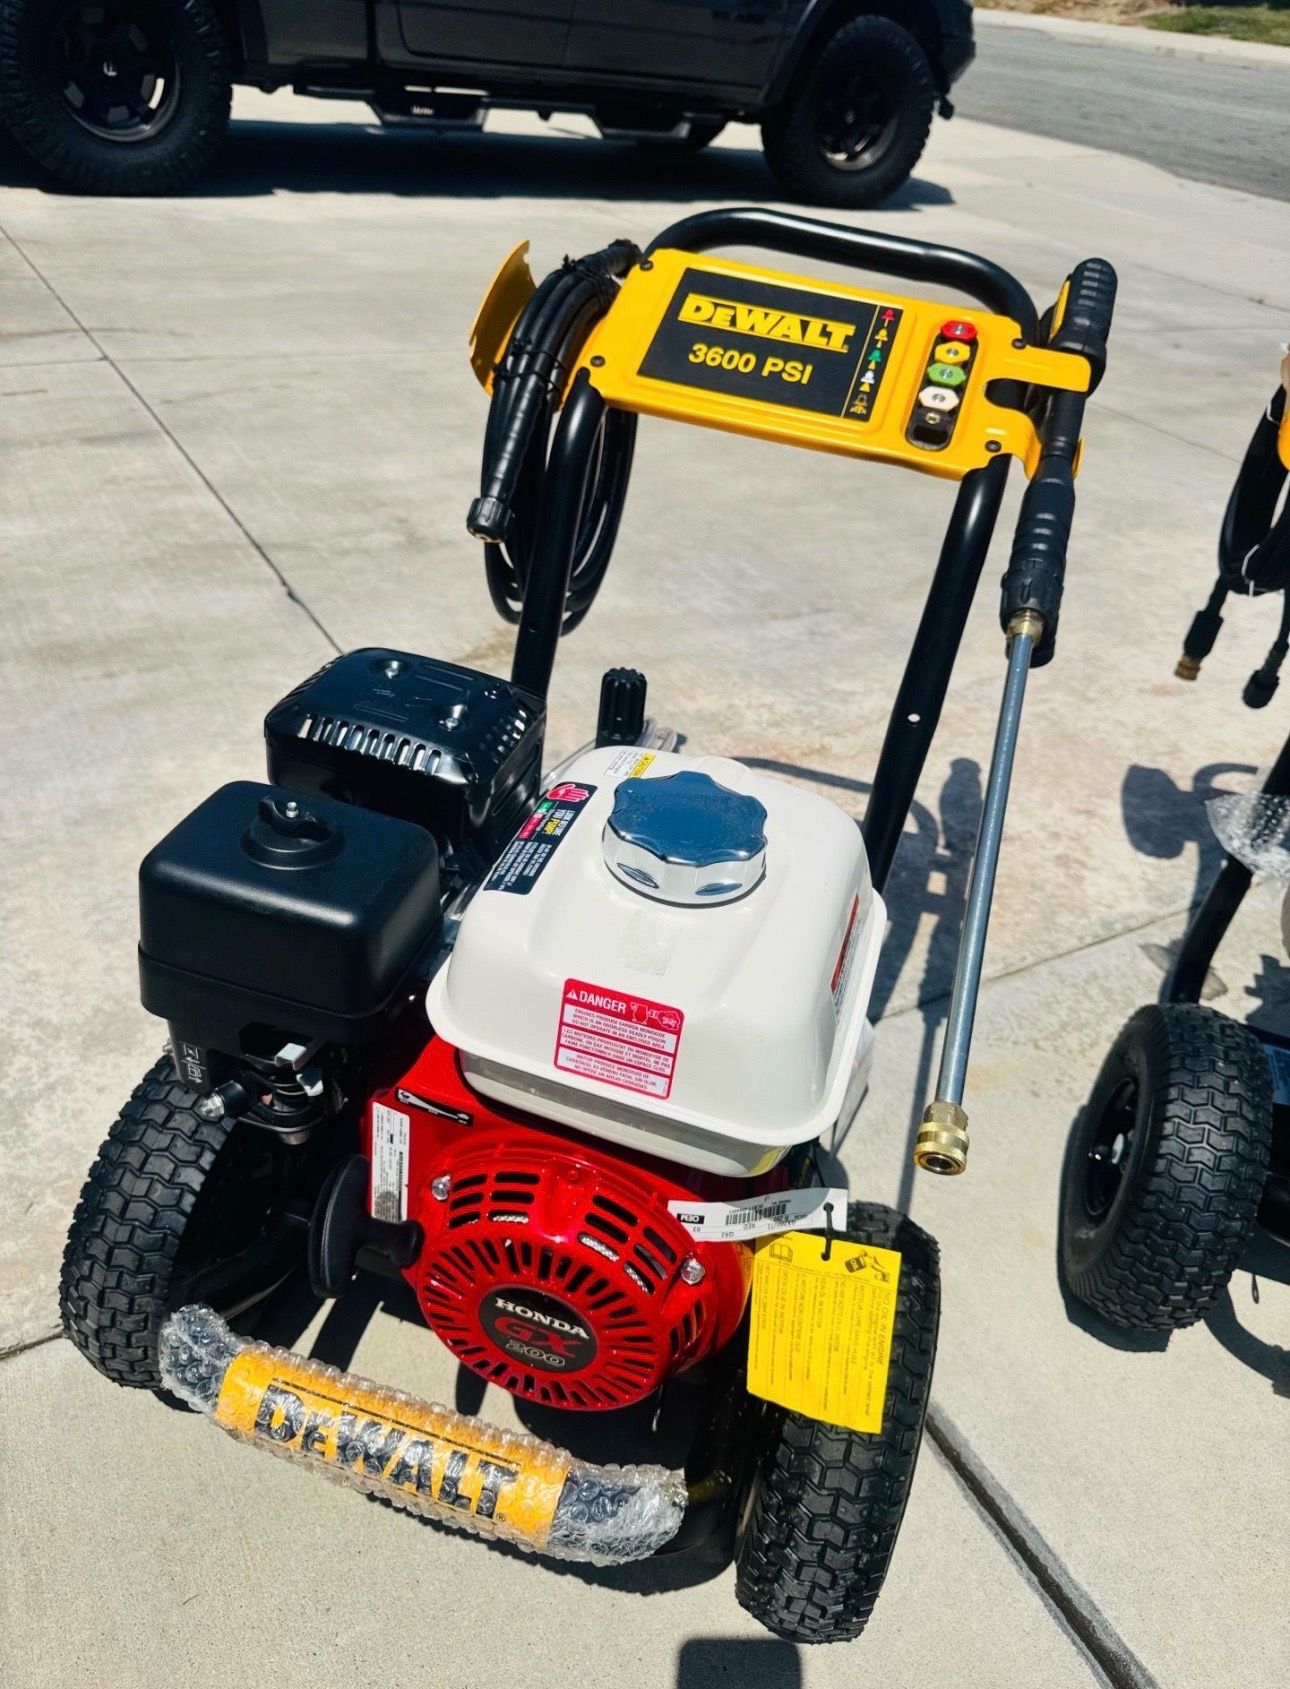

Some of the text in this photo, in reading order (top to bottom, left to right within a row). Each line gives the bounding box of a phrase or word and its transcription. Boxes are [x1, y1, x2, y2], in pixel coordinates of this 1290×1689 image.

[678, 294, 856, 353] DEWALT
[687, 343, 814, 385] 3600 PSI
[579, 989, 627, 1014] DANGER
[680, 1213, 700, 1224] OEM
[494, 1316, 584, 1358] GX
[495, 1297, 590, 1339] HONDA
[505, 1339, 566, 1367] 200
[253, 1382, 520, 1519] DEWALT
